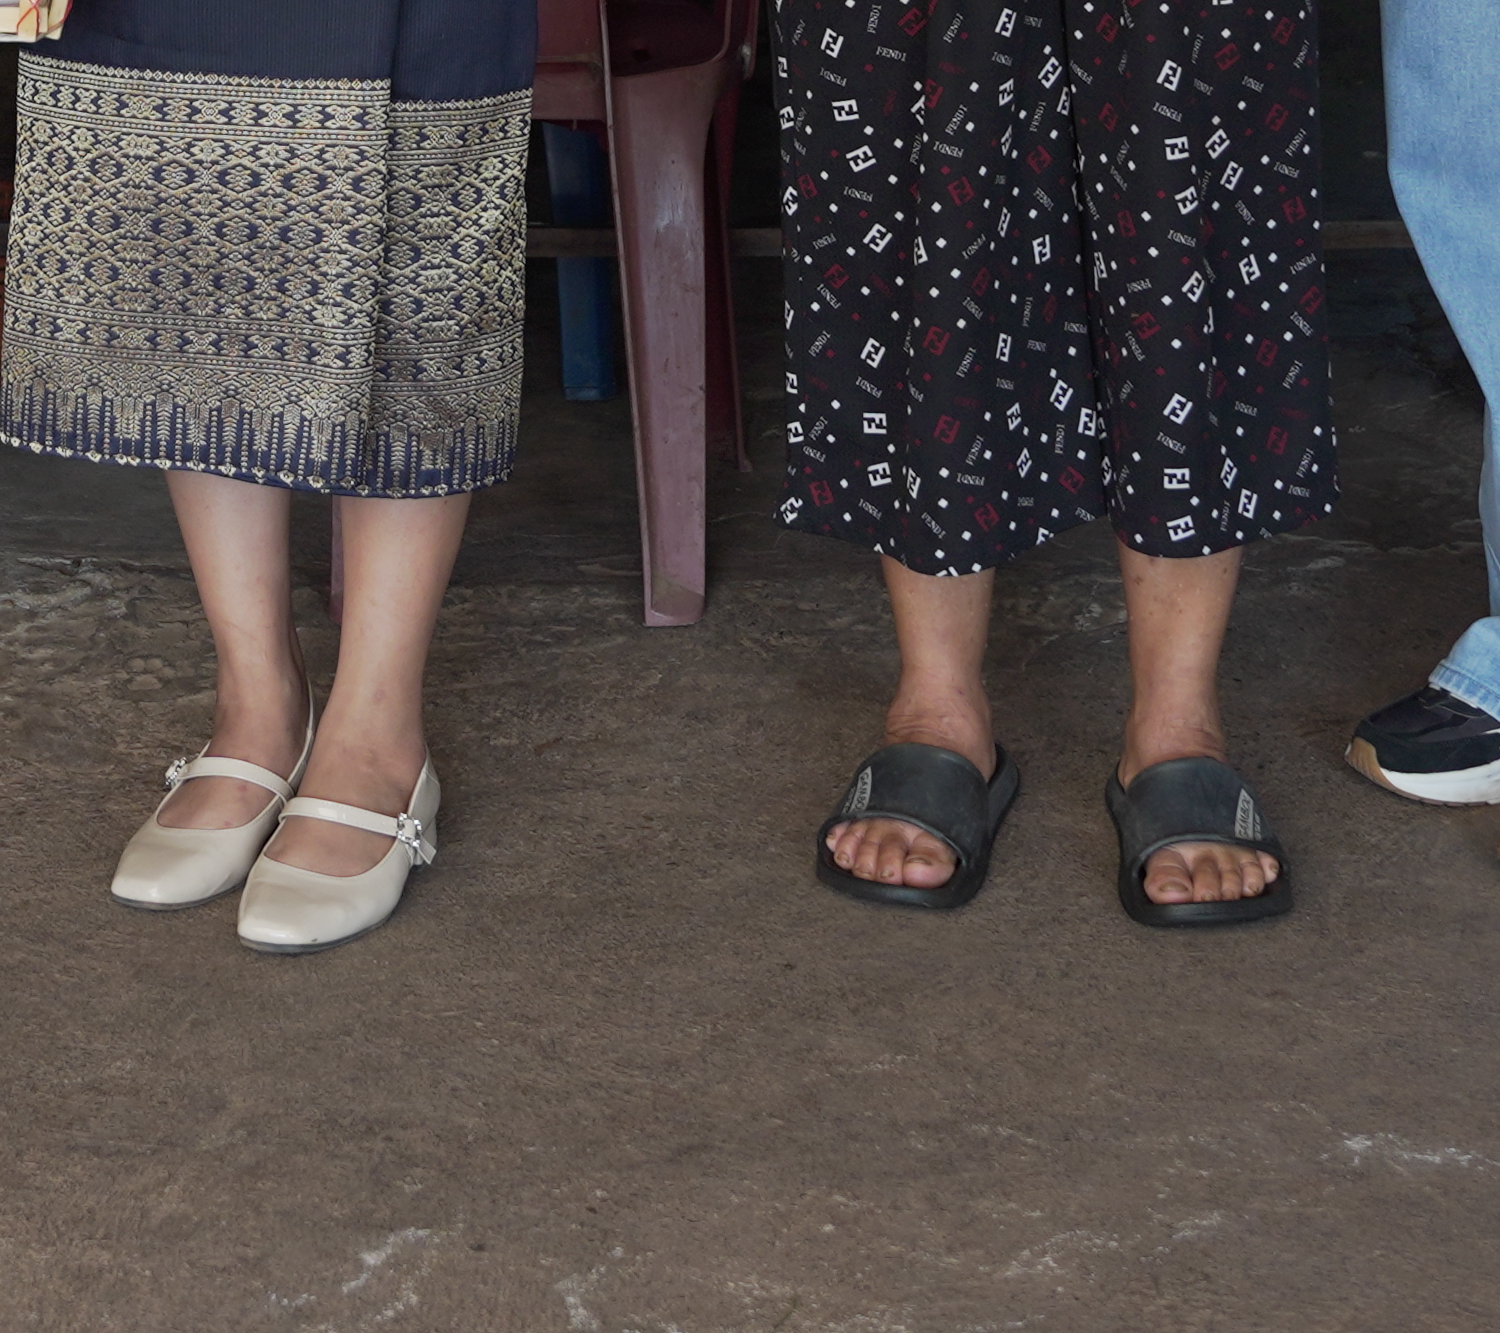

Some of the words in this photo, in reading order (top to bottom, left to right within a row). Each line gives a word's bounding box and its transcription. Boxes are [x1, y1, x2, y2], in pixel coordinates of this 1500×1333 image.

[867, 4, 882, 34] FENDI
[943, 13, 964, 43] FENDI
[876, 46, 907, 62] FENDI
[820, 67, 847, 87] FENDI
[945, 104, 968, 136] FENDI
[1029, 101, 1046, 132] FENDI
[1152, 101, 1182, 122] FENDI
[910, 132, 922, 165] FENDI
[933, 141, 964, 158] FENDI
[843, 186, 873, 202] FENDI
[1033, 187, 1054, 211] FENDI
[961, 233, 986, 260] FENDI
[1167, 229, 1196, 247] FENDI
[1289, 253, 1317, 275] FENDI
[816, 283, 841, 309] FENDI
[808, 330, 831, 357] FENDI
[956, 347, 976, 378] FENDI
[1282, 360, 1303, 389] FENDI
[855, 376, 882, 398] FENDI
[808, 416, 828, 441] FENDI
[1054, 424, 1065, 454] FENDI
[965, 434, 984, 466] FENDI
[1156, 431, 1186, 454] FENDI
[957, 473, 985, 486] FENDI
[921, 512, 946, 539] FENDI
